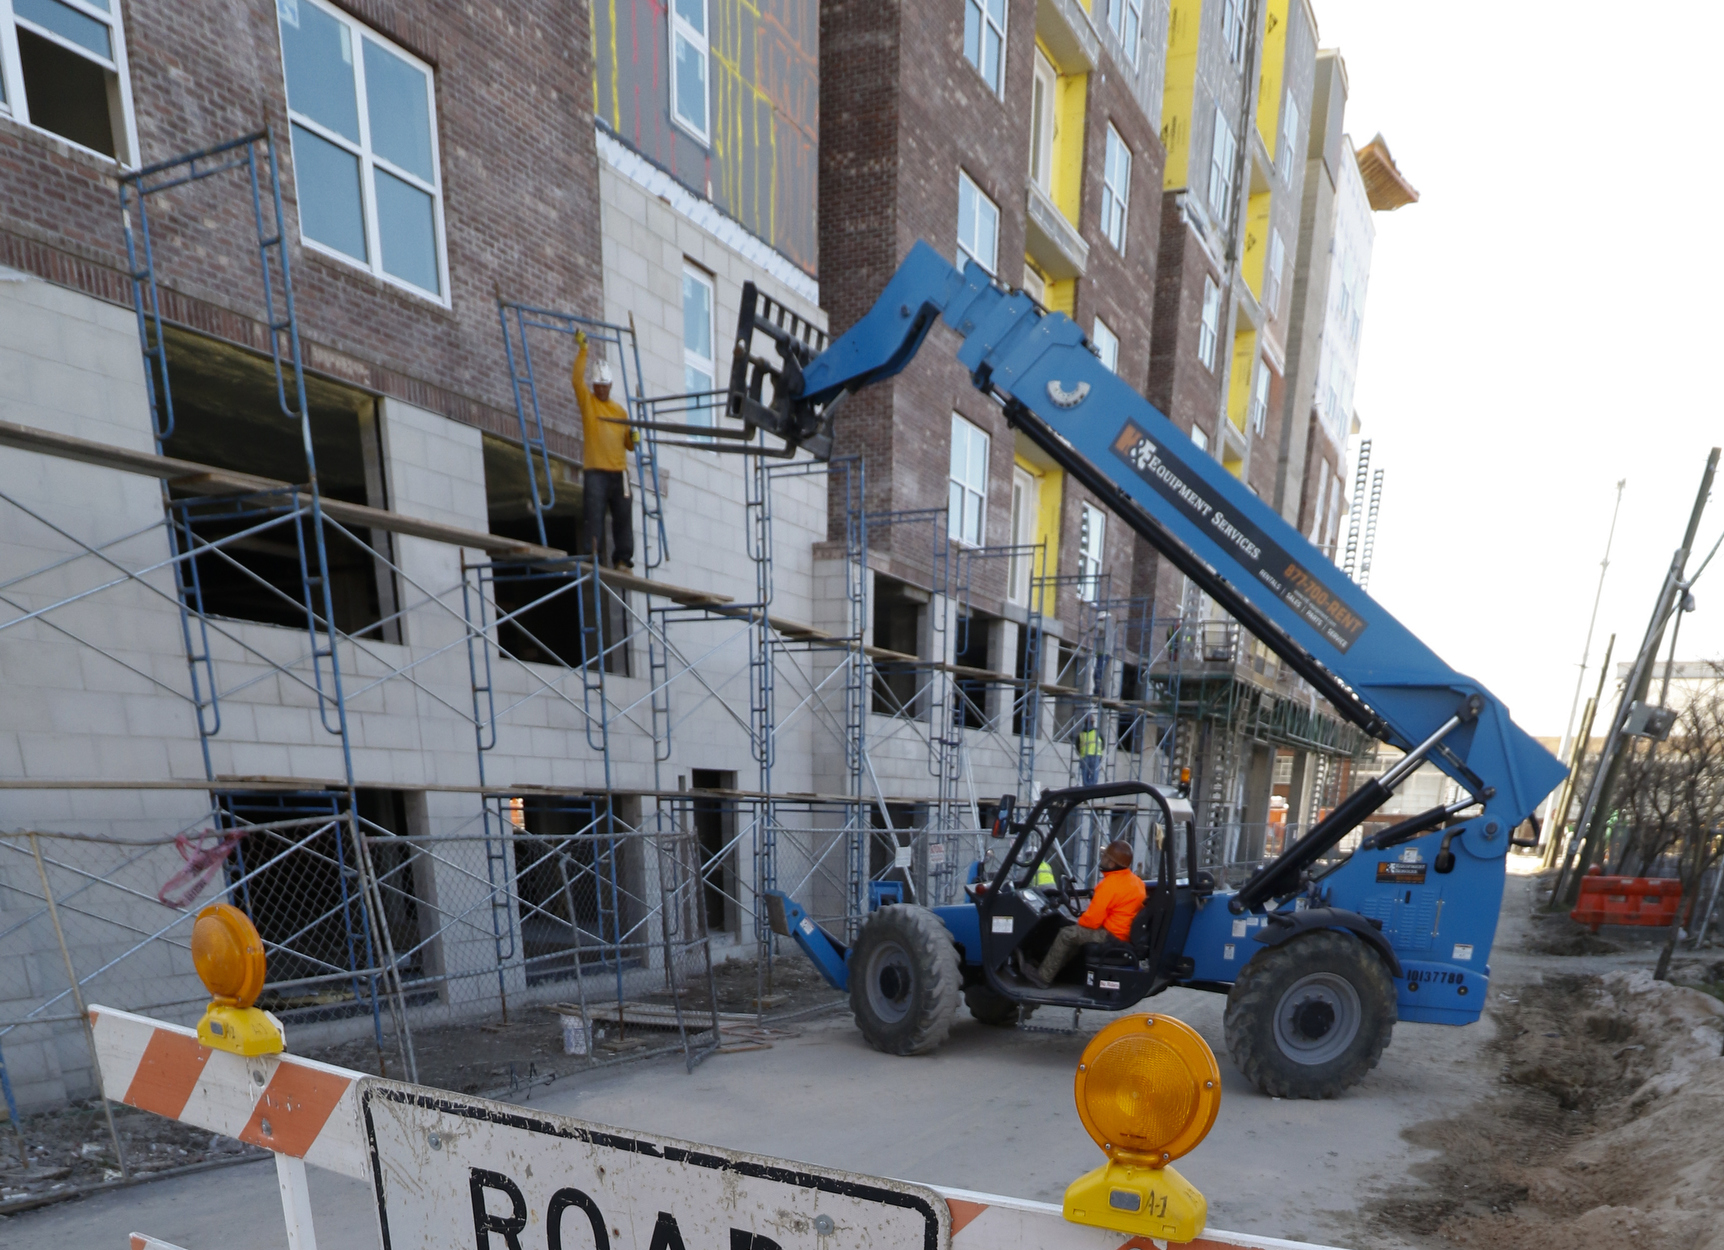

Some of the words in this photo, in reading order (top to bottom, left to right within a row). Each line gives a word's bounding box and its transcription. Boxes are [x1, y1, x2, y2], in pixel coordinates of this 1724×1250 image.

[1148, 456, 1212, 517] EQUIPMENT
[1211, 511, 1261, 560] SERVICES
[1259, 569, 1281, 590] RENTALS
[1286, 592, 1302, 608] SALES
[1306, 609, 1323, 627] PARTS
[1327, 628, 1348, 648] SERVICE
[1284, 563, 1363, 633] 877-700-RENT
[1407, 969, 1464, 985] 10137780
[1145, 1189, 1168, 1219] A-1
